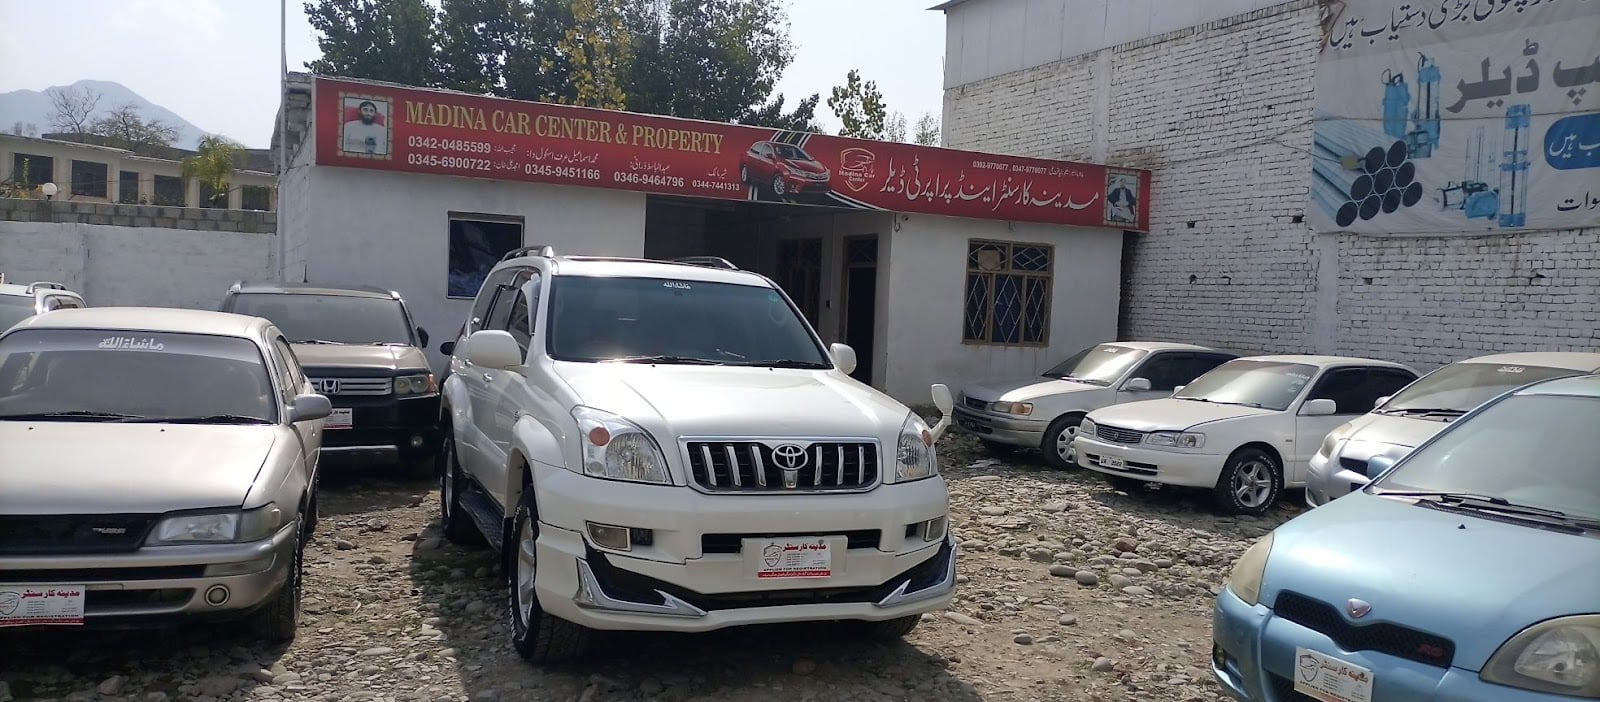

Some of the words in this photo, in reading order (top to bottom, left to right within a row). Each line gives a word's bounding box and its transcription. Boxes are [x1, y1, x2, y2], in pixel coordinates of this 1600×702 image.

[1329, 17, 1358, 49] ہیں
[1446, 38, 1540, 114] ڈیلر
[405, 100, 488, 131] MADINA
[491, 110, 531, 135] CAR
[535, 114, 612, 143] CENTER
[615, 122, 627, 145] &
[631, 124, 724, 154] PROPERTY
[408, 135, 491, 153] 0342-0485599
[1549, 132, 1577, 158] ہیں
[407, 153, 491, 171] 0345-6900722
[525, 163, 600, 180] 0345-9451166
[838, 169, 863, 178] Madina
[613, 171, 684, 188] 0346-9464796
[692, 179, 740, 191] 0344-7441313
[879, 156, 907, 194] ڈیلر
[953, 169, 997, 203] اینڈ
[1014, 179, 1033, 206] کار
[1027, 188, 1100, 211] مدینہ
[1556, 191, 1600, 212] وات
